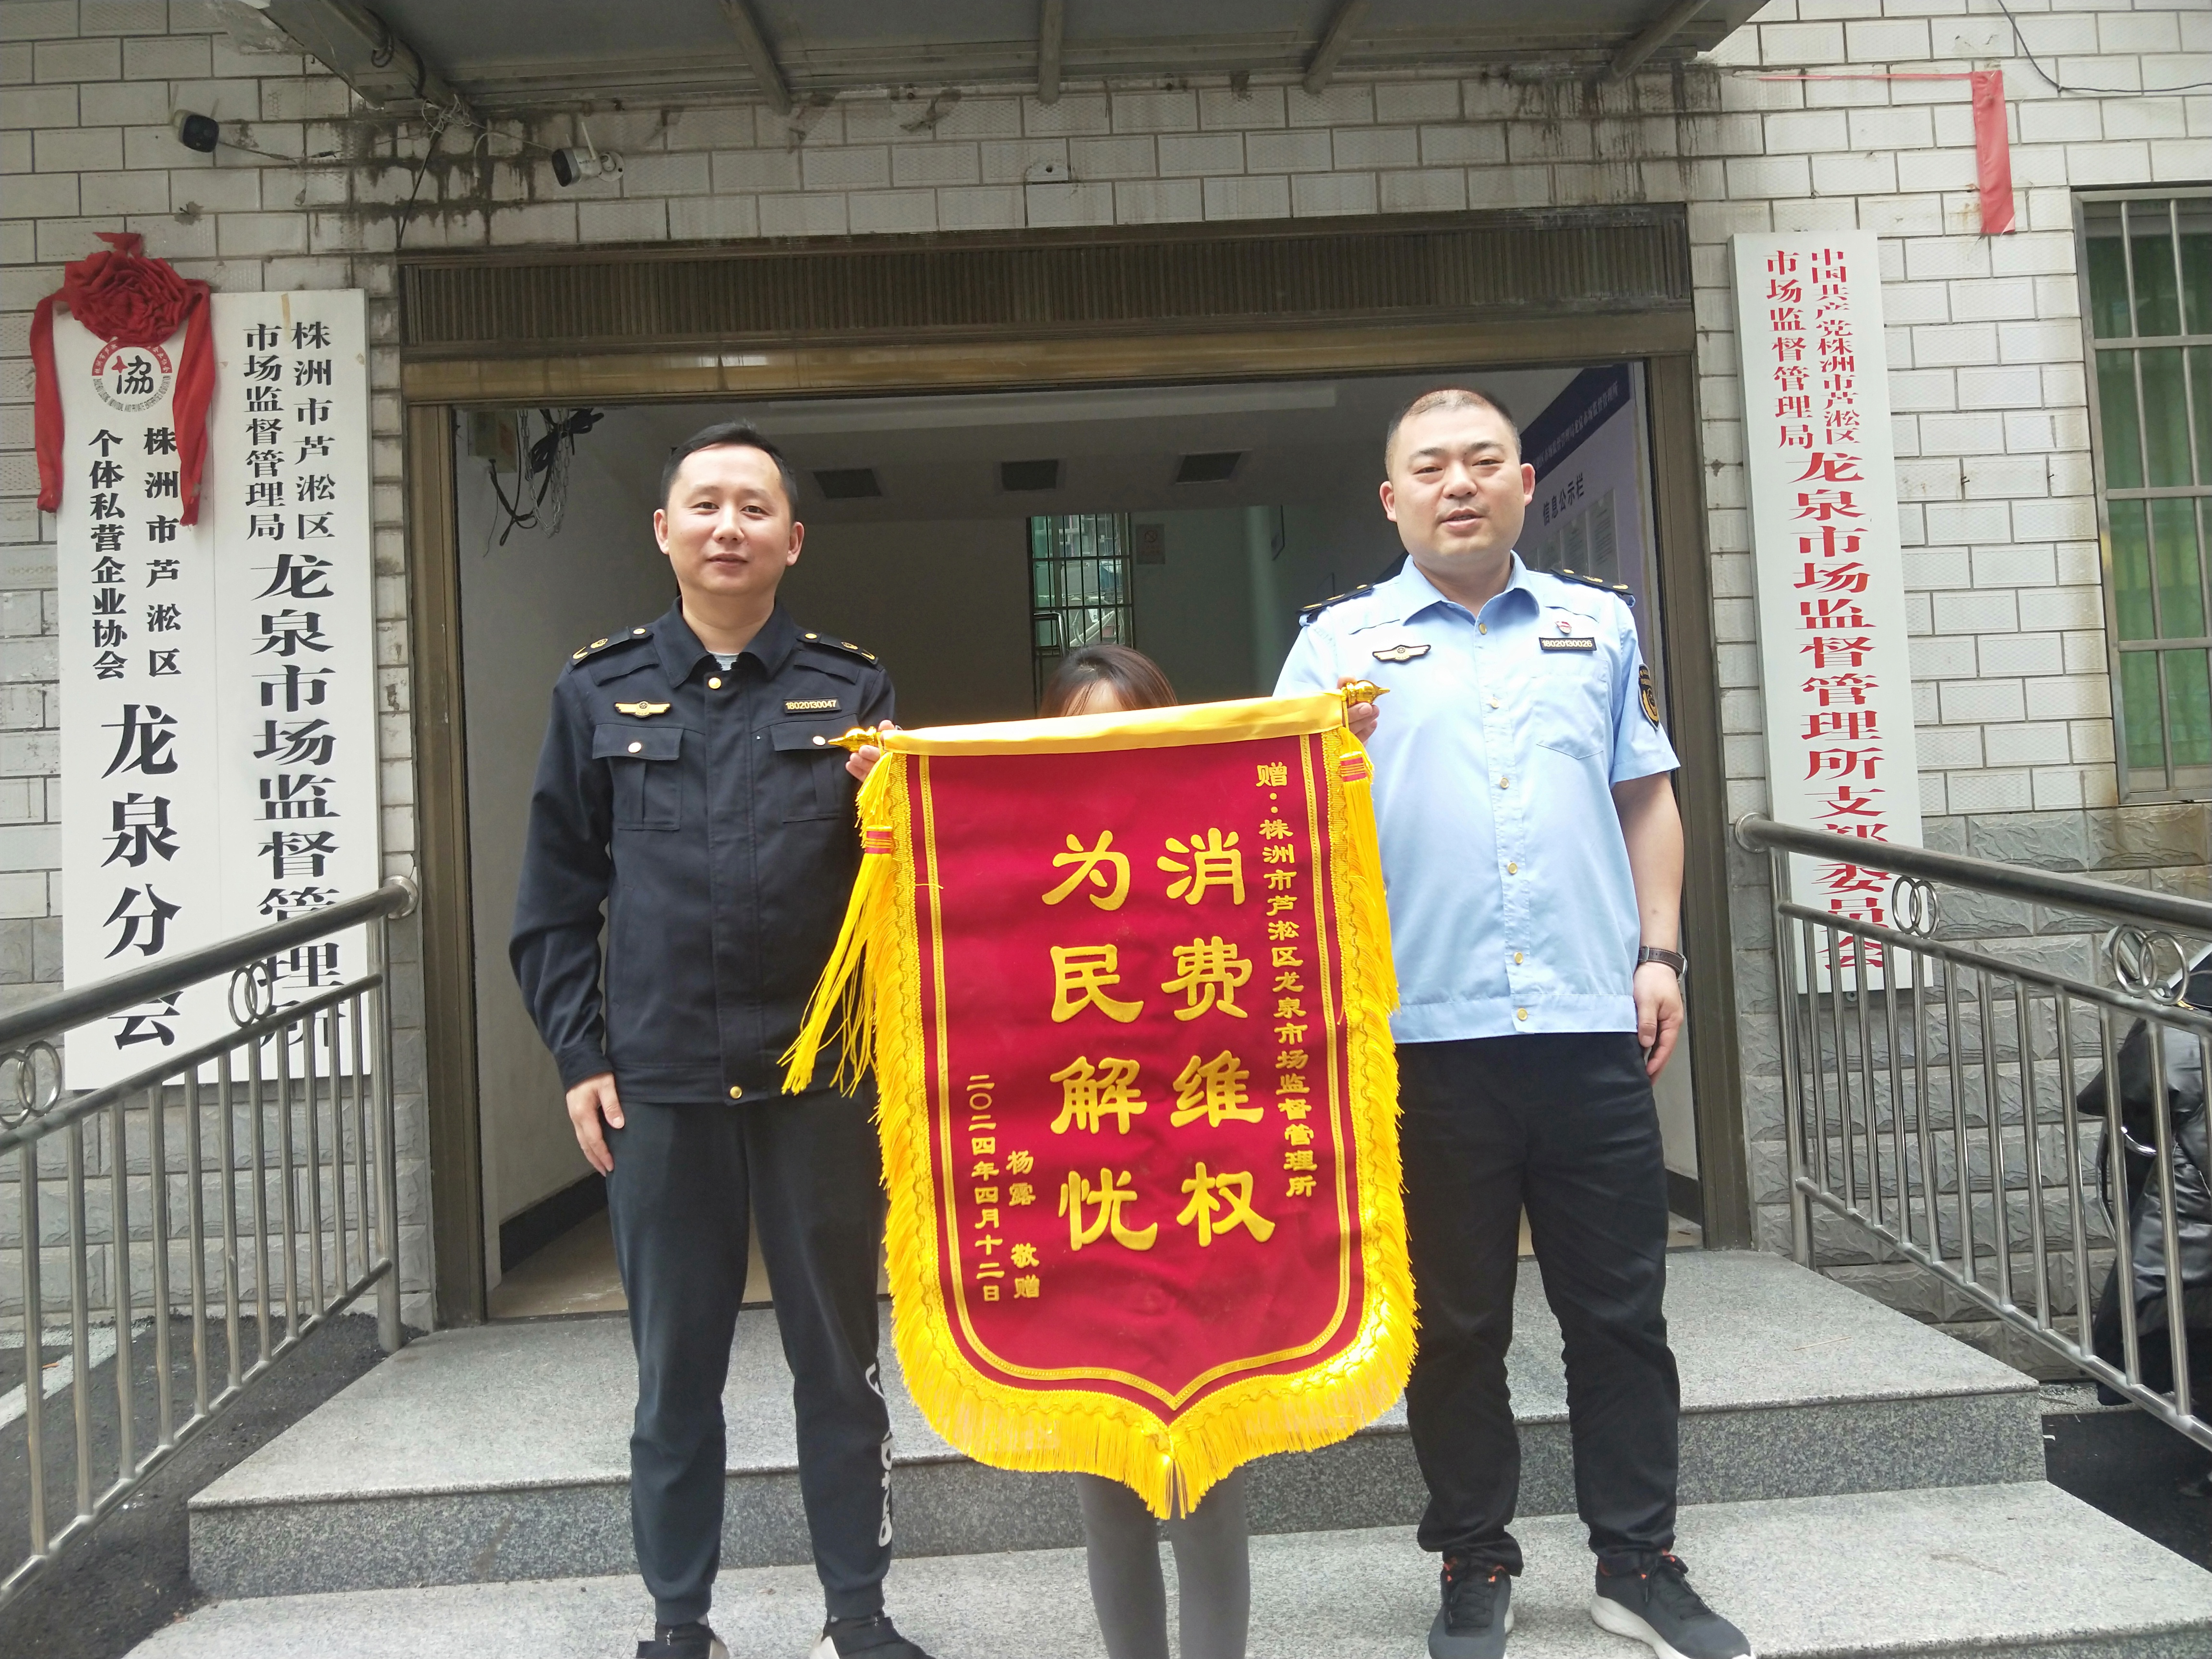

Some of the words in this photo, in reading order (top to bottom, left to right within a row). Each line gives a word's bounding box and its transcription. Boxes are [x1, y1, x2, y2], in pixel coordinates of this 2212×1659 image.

[243, 323, 286, 541] 市场监督管理局
[291, 321, 336, 541] 株洲市芦淞区
[1764, 250, 1814, 449] 市场监督管理局
[1811, 248, 1861, 445] 中国共产党株洲市芦淞区
[88, 429, 128, 680] 个体私营企业协会
[144, 426, 182, 677] 株洲市芦淞区
[785, 700, 837, 709] 18020130047
[1042, 830, 1158, 1251] 为民解忧
[1157, 827, 1275, 1247] 消费维权
[1010, 1242, 1040, 1298] 敬赠
